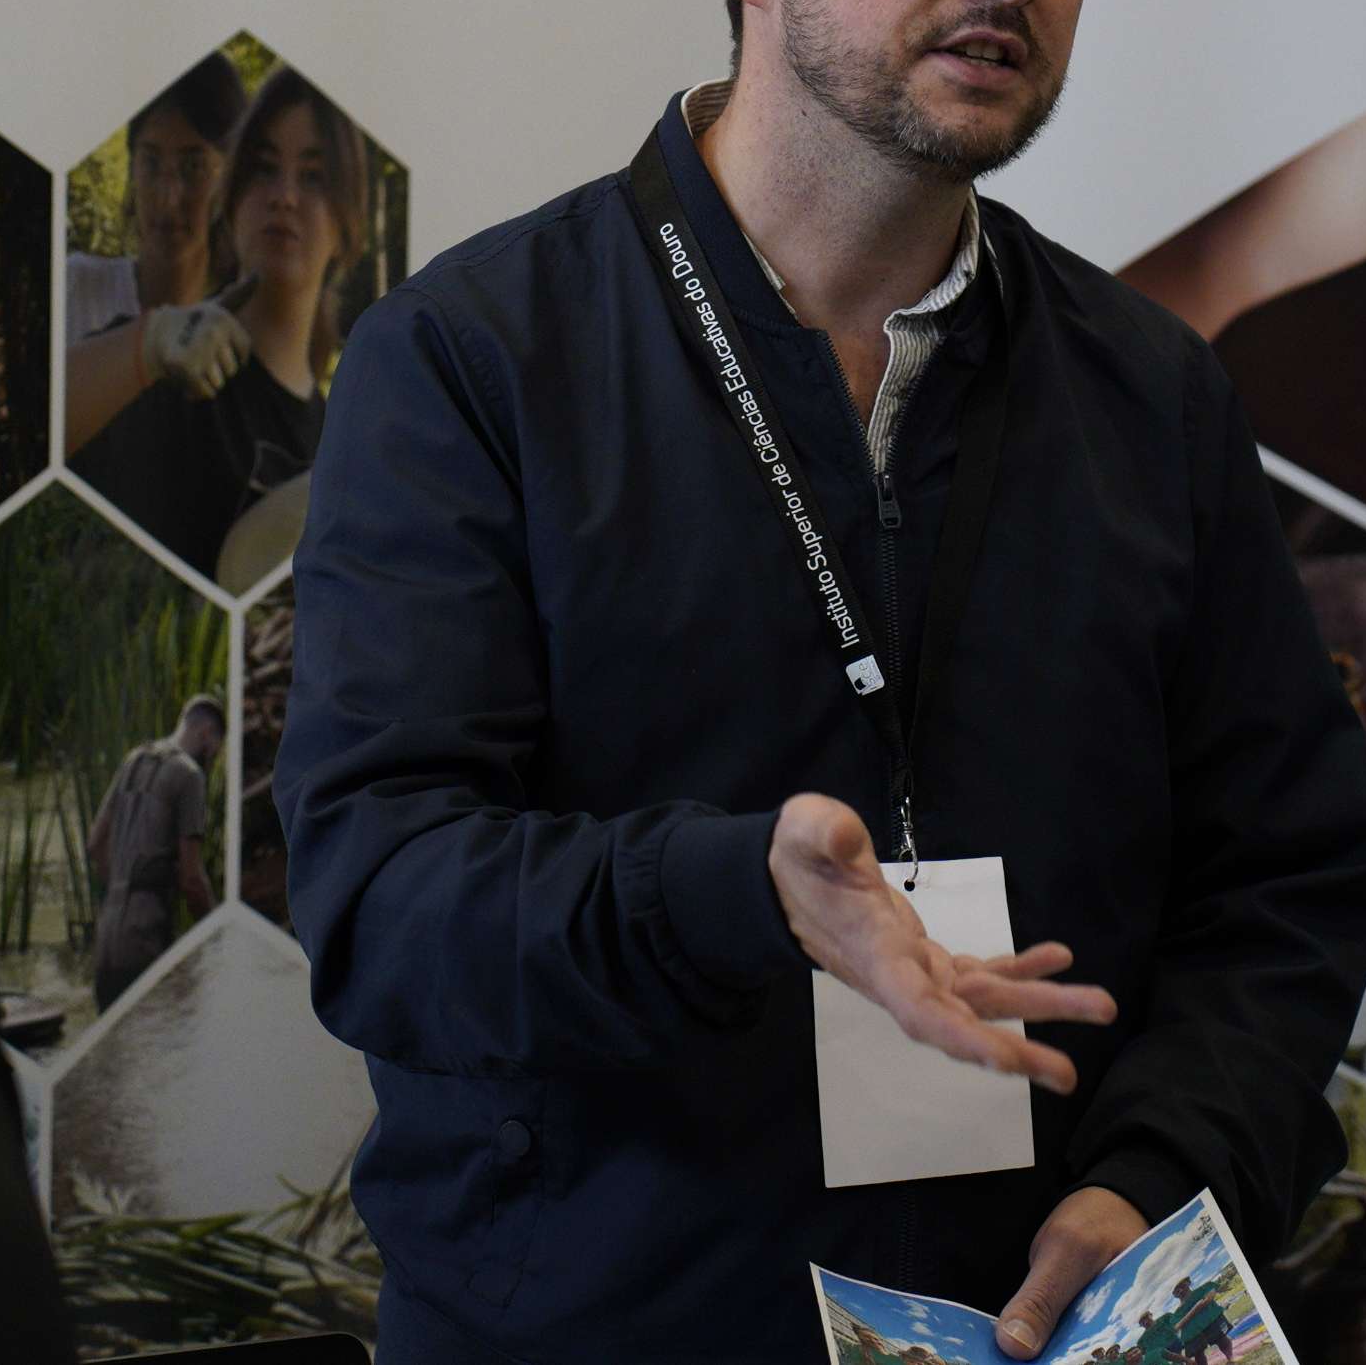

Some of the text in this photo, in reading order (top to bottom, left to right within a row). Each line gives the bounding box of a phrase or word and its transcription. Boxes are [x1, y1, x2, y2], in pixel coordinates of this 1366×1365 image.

[659, 222, 860, 649] Instituto Superior de Ciências Educativas do Douro
